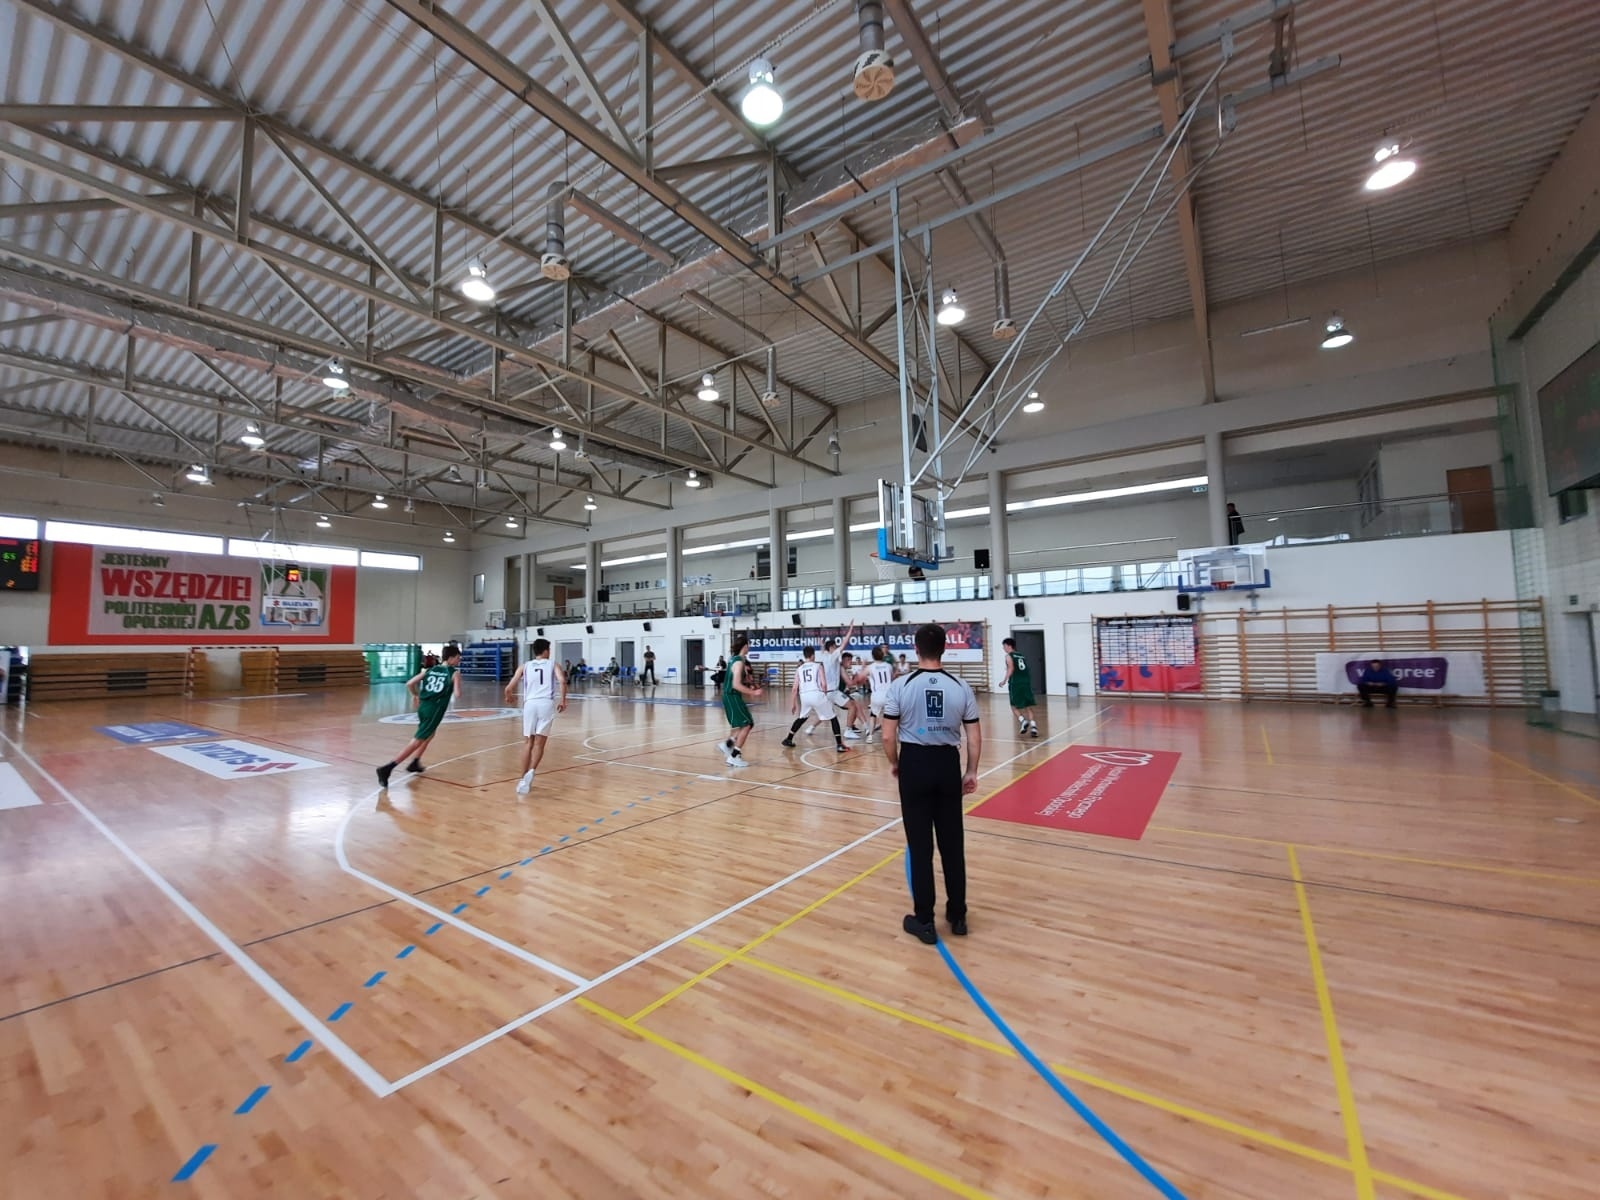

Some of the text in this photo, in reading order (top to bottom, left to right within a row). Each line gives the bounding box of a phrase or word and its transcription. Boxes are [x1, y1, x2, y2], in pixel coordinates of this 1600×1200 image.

[101, 552, 170, 568] JESTEŚMY
[101, 567, 252, 602] WSZĘDZIE!
[104, 600, 197, 616] POLITECHNIKI
[282, 600, 313, 608] SUZUKI
[122, 615, 196, 629] OPOLSKIEJ
[198, 604, 251, 631] AZS
[1018, 658, 1026, 671] 8
[534, 668, 544, 685] 7
[802, 668, 813, 683] 15
[878, 671, 888, 684] 11
[425, 675, 446, 693] 35
